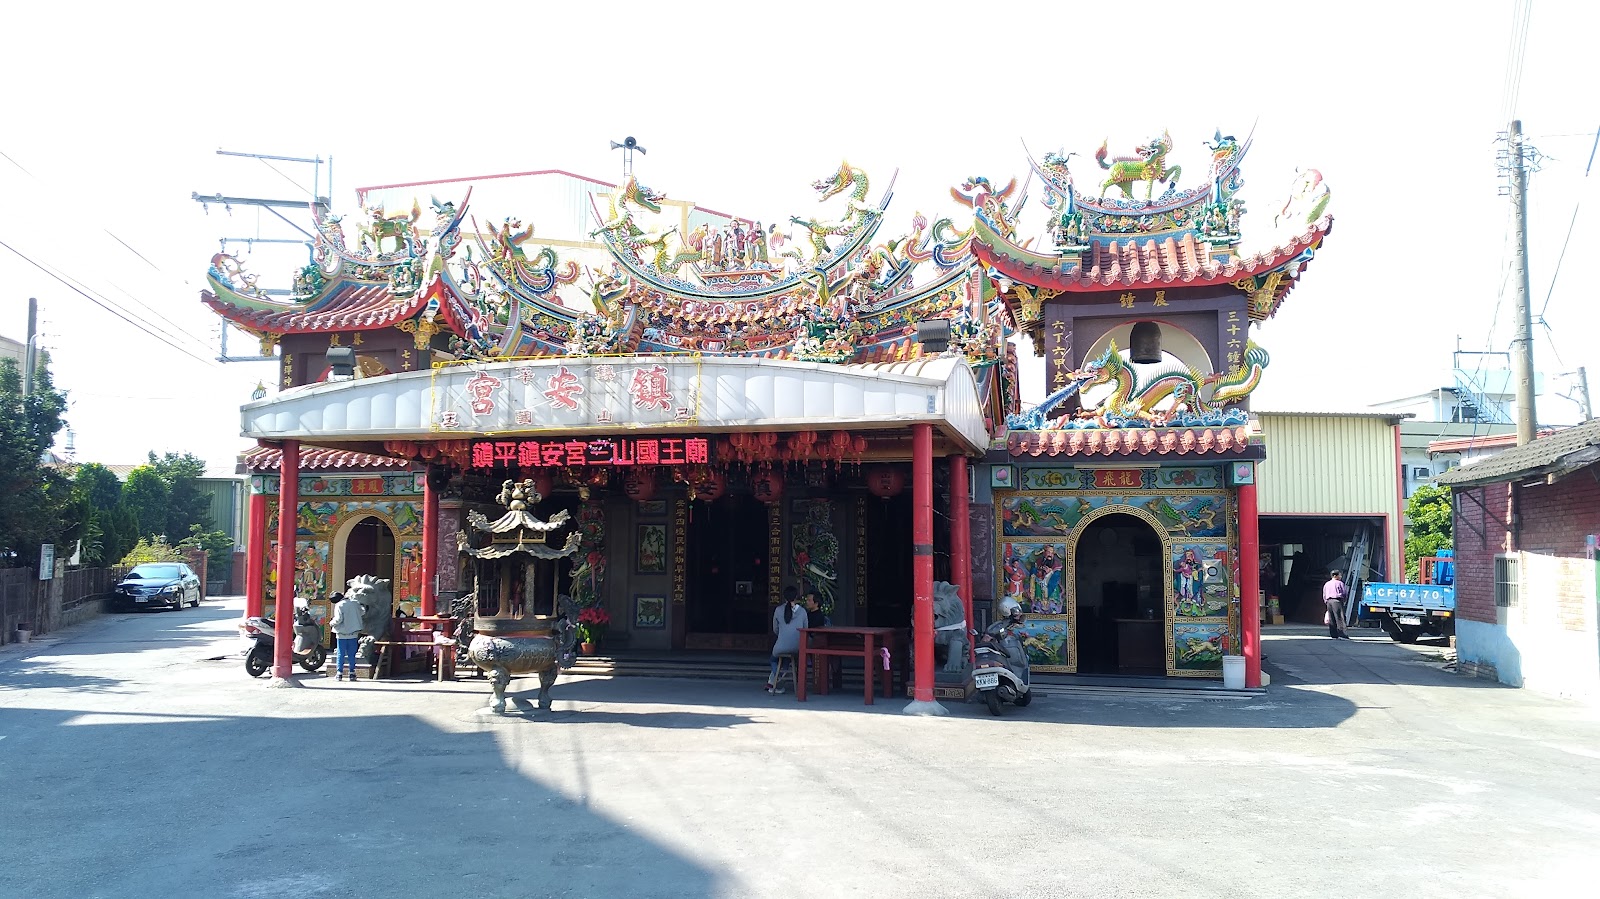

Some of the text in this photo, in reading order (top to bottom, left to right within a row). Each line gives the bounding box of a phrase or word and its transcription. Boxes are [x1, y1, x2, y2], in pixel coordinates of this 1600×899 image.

[1119, 290, 1170, 309] 晨鐘
[1052, 320, 1066, 409] 六丁六甲左
[467, 364, 674, 416] 鎮安宮
[472, 437, 709, 468] 鎮平鎮安宮三山國王廟
[1101, 470, 1135, 487] 龍飛
